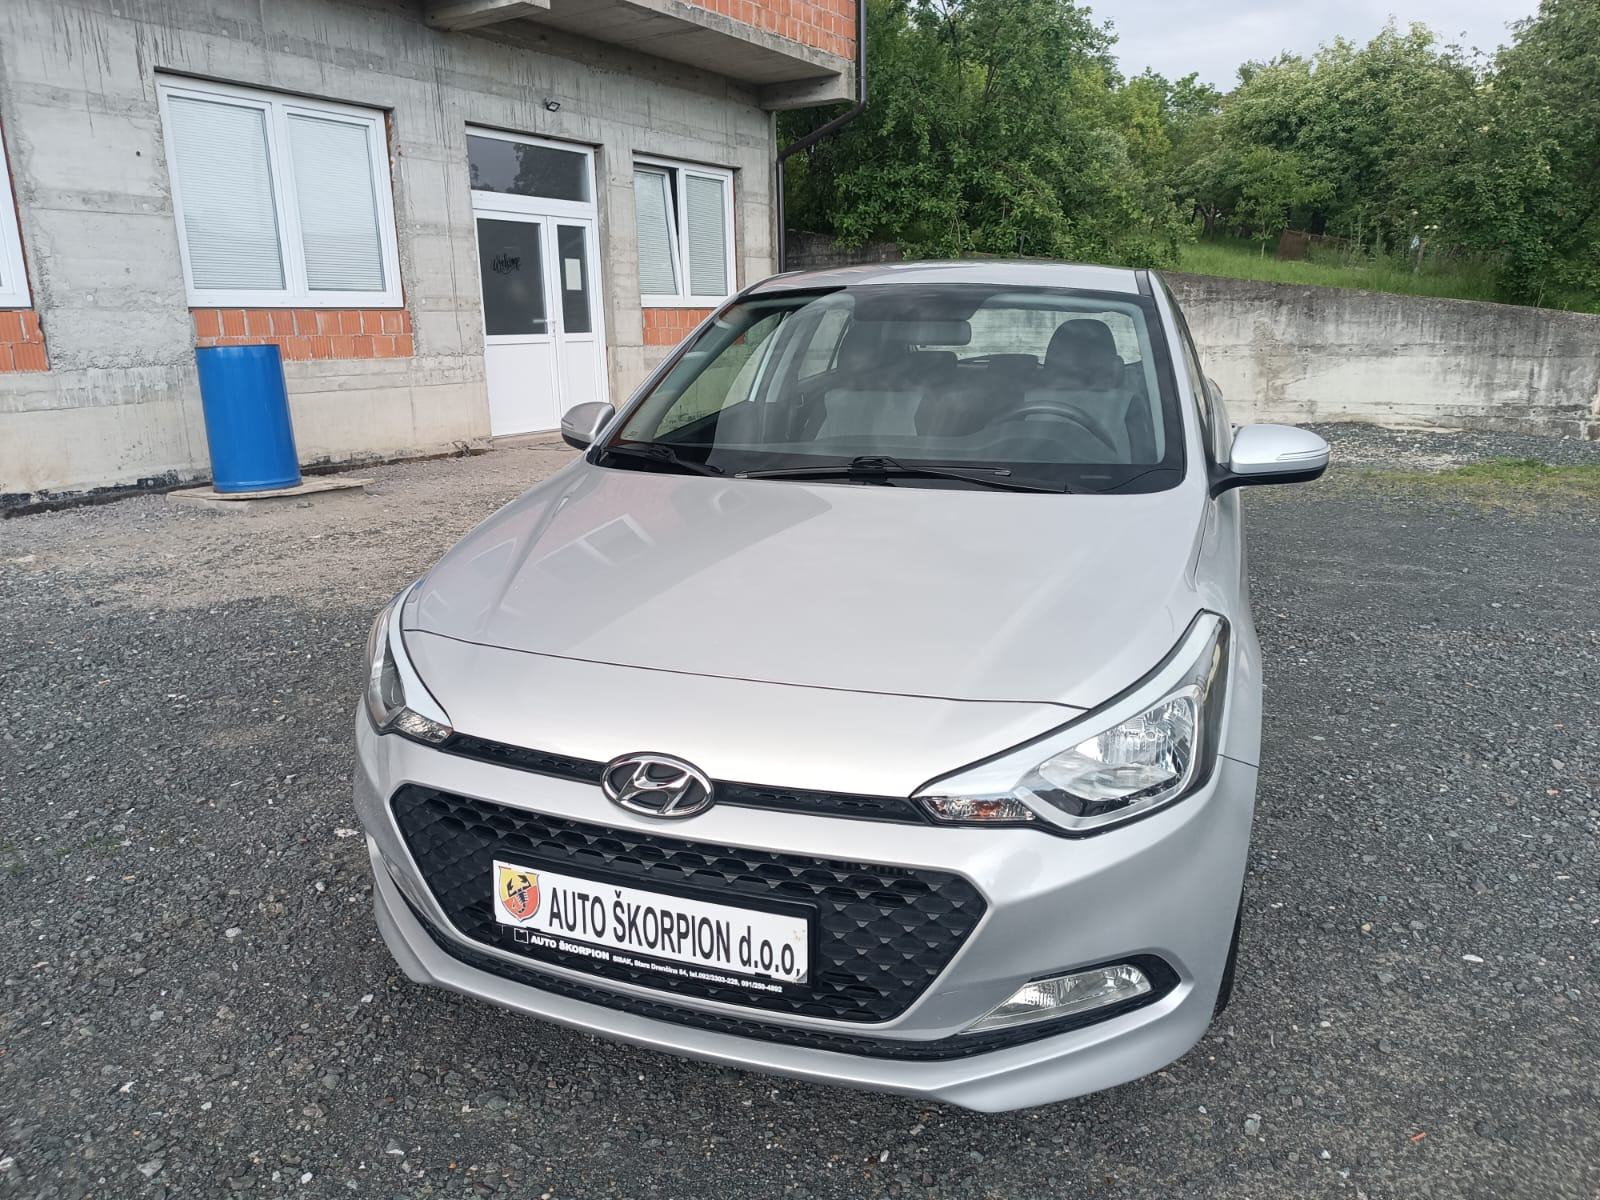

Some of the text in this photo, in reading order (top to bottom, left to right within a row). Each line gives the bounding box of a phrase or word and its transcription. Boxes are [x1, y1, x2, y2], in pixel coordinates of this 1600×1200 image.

[530, 935, 557, 949] AUTO
[558, 940, 610, 961] ŠKORPION
[549, 887, 606, 938] AUTO
[613, 890, 731, 964] ŠKORPION
